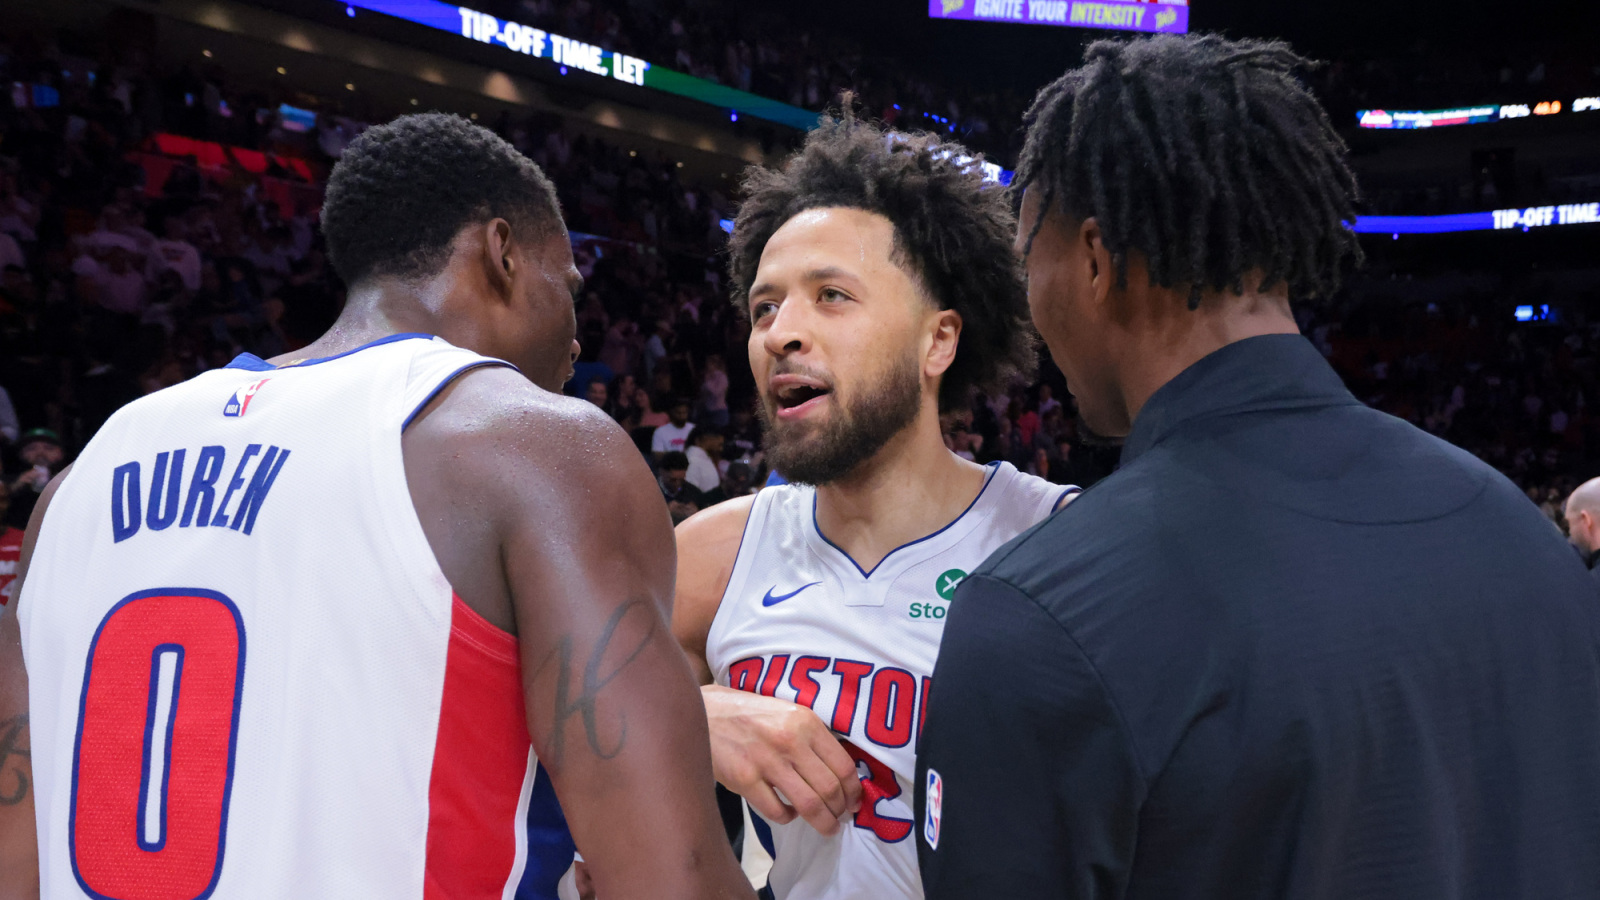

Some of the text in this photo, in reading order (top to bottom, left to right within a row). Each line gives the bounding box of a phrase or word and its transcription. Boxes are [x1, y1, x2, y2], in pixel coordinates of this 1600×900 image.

[458, 6, 546, 58] TIP-OFF
[613, 52, 648, 86] LET
[974, 0, 1024, 19] IGNITE
[1028, 0, 1068, 22] YOUR
[1070, 2, 1146, 27] INTENSITY
[1492, 206, 1555, 230] TIP-OFF
[111, 443, 291, 543] DUREN
[69, 587, 247, 900] 0
